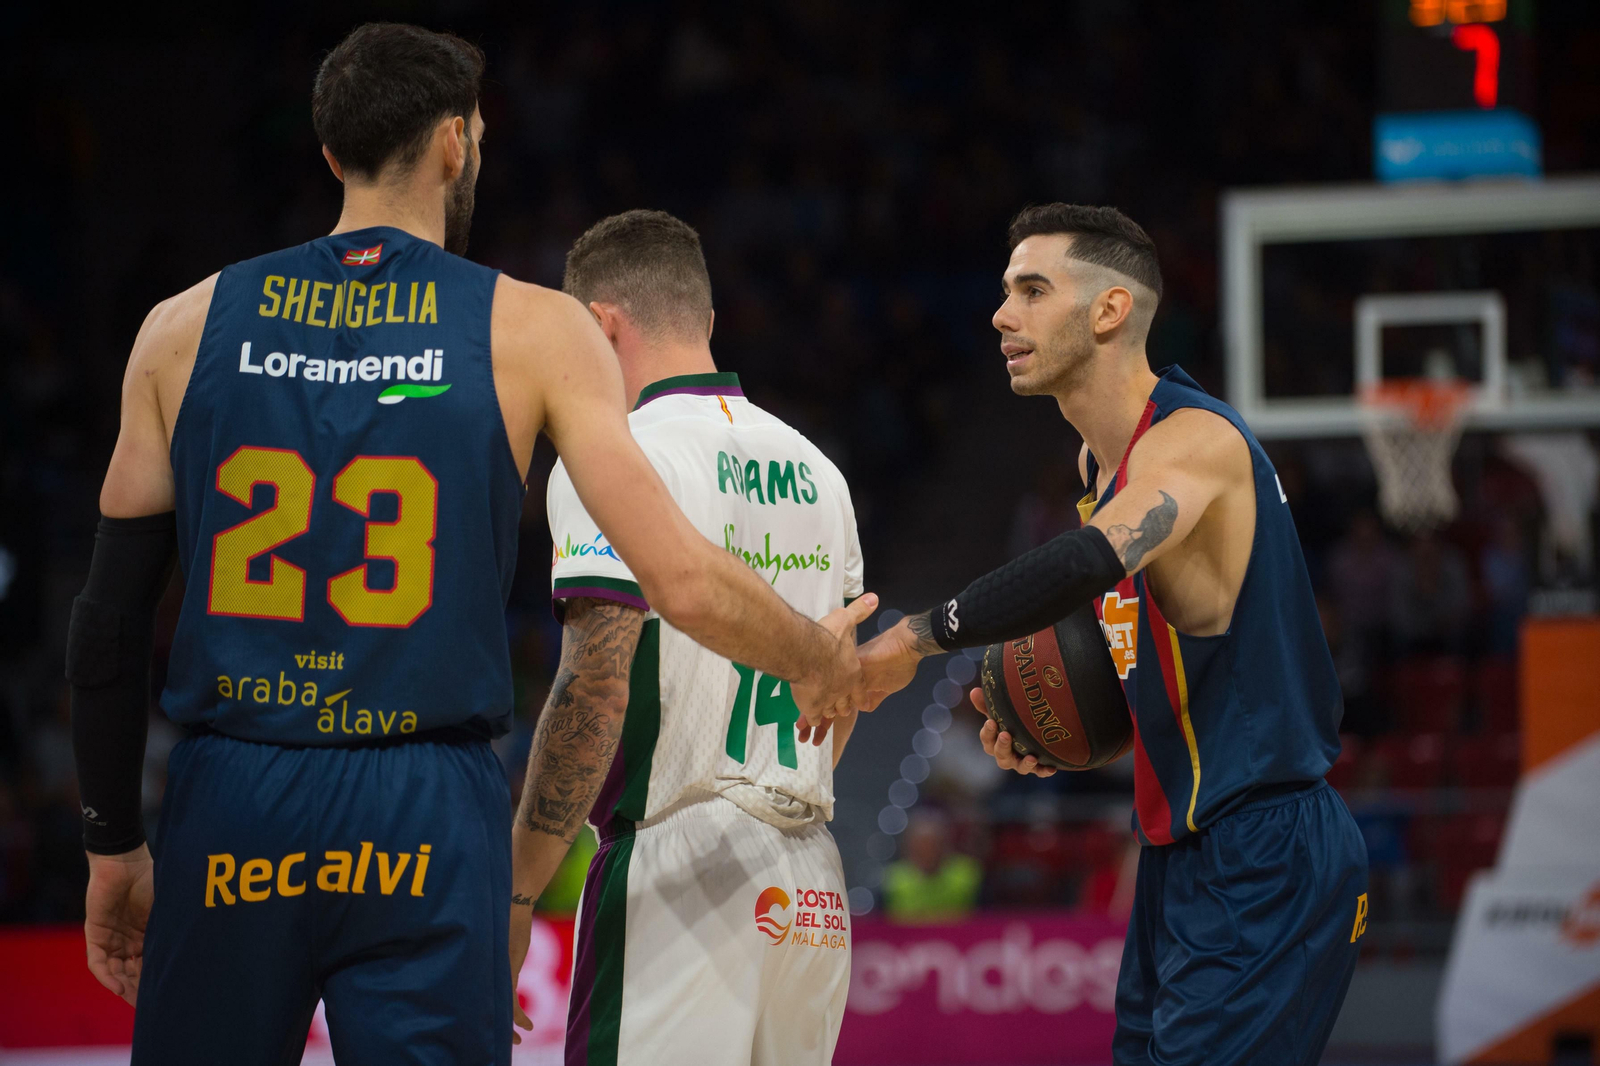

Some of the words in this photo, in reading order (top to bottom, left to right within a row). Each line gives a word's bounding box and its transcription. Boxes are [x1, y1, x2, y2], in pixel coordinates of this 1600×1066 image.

[1452, 23, 1500, 110] 7
[258, 275, 438, 329] SHENGELIA
[239, 341, 444, 384] Loramendi
[717, 450, 818, 505] ADAMS
[207, 445, 439, 629] 23
[295, 650, 344, 670] visit
[217, 671, 318, 706] araba
[205, 841, 432, 908] Recalvi
[795, 912, 821, 928] DEL
[824, 914, 846, 931] SOL
[797, 889, 844, 911] COSTA
[791, 929, 846, 950] MÁLAGA
